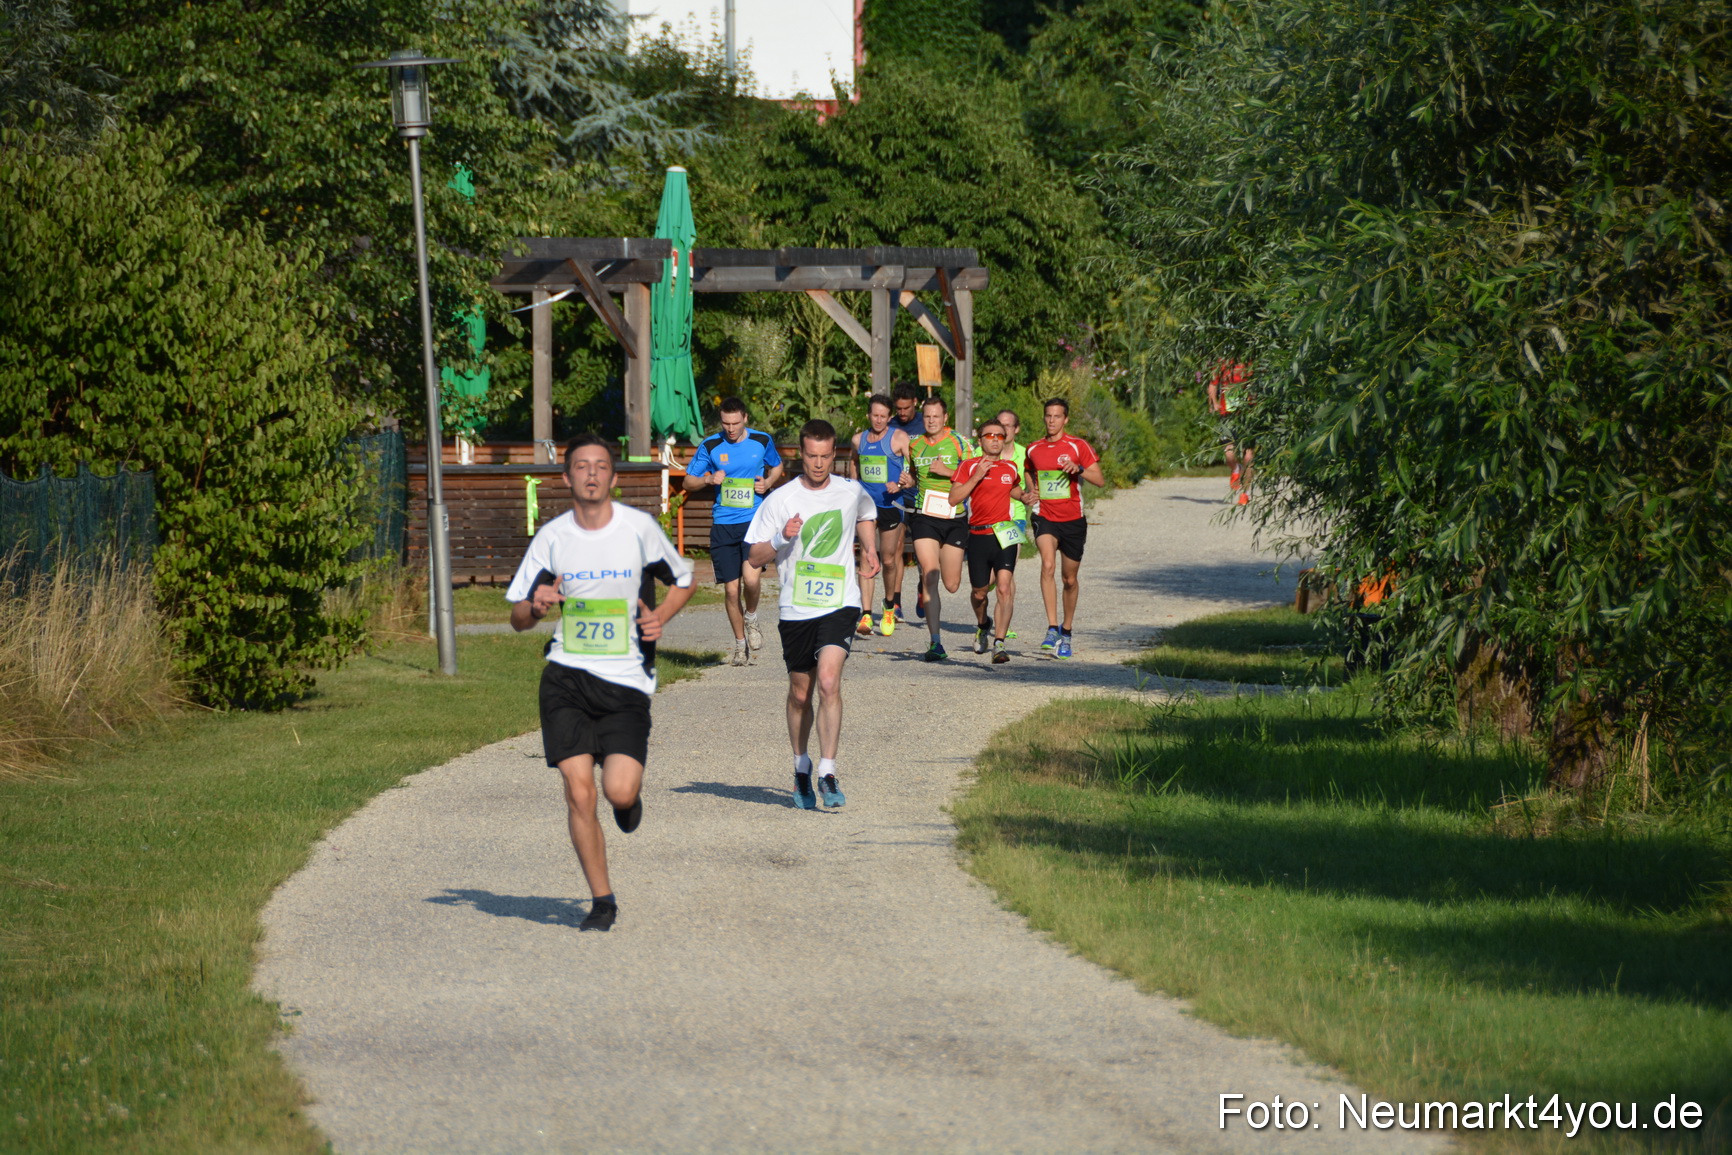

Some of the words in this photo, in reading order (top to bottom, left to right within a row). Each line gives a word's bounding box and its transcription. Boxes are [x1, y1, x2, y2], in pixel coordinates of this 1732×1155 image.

[864, 466, 881, 476] 648
[724, 488, 751, 500] 1284
[1006, 528, 1019, 541] 28
[561, 569, 632, 582] DELPHI
[804, 579, 835, 597] 125
[575, 621, 616, 640] 278
